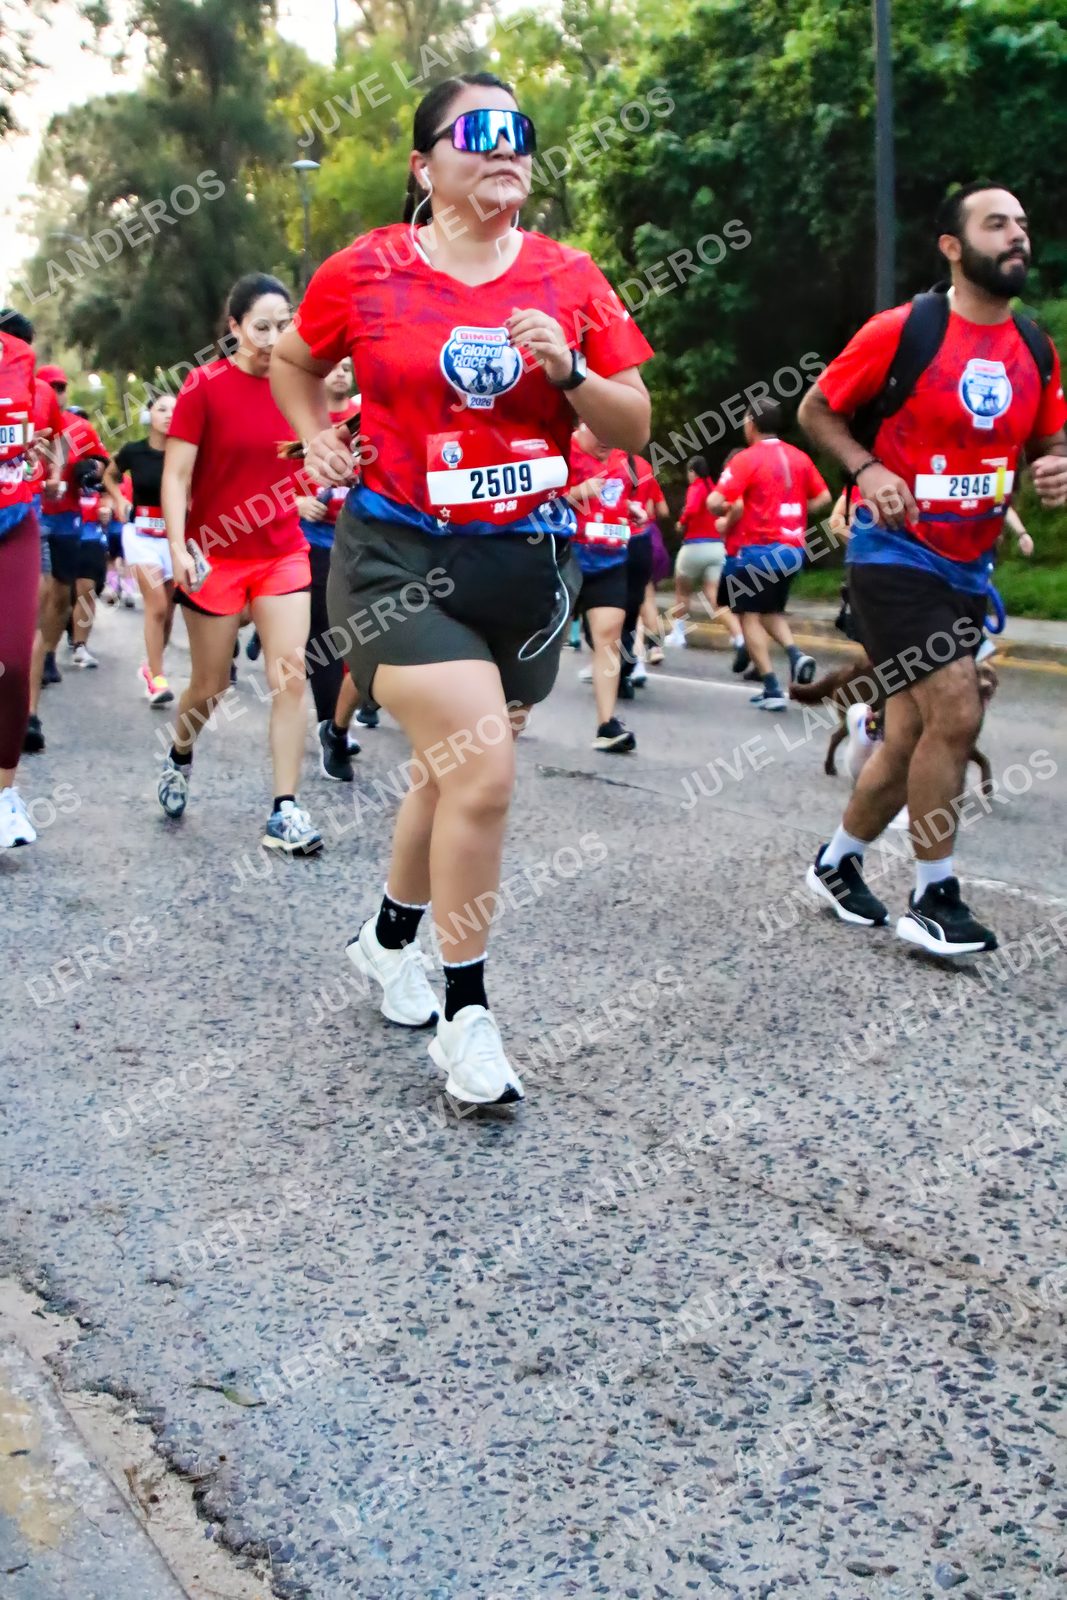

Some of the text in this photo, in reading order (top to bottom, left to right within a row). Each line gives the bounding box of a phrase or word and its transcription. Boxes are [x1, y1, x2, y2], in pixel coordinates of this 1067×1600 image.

[461, 343, 503, 358] Global
[453, 355, 487, 368] Race
[470, 396, 492, 407] 2026
[470, 463, 532, 499] 2509
[949, 476, 990, 497] 2946
